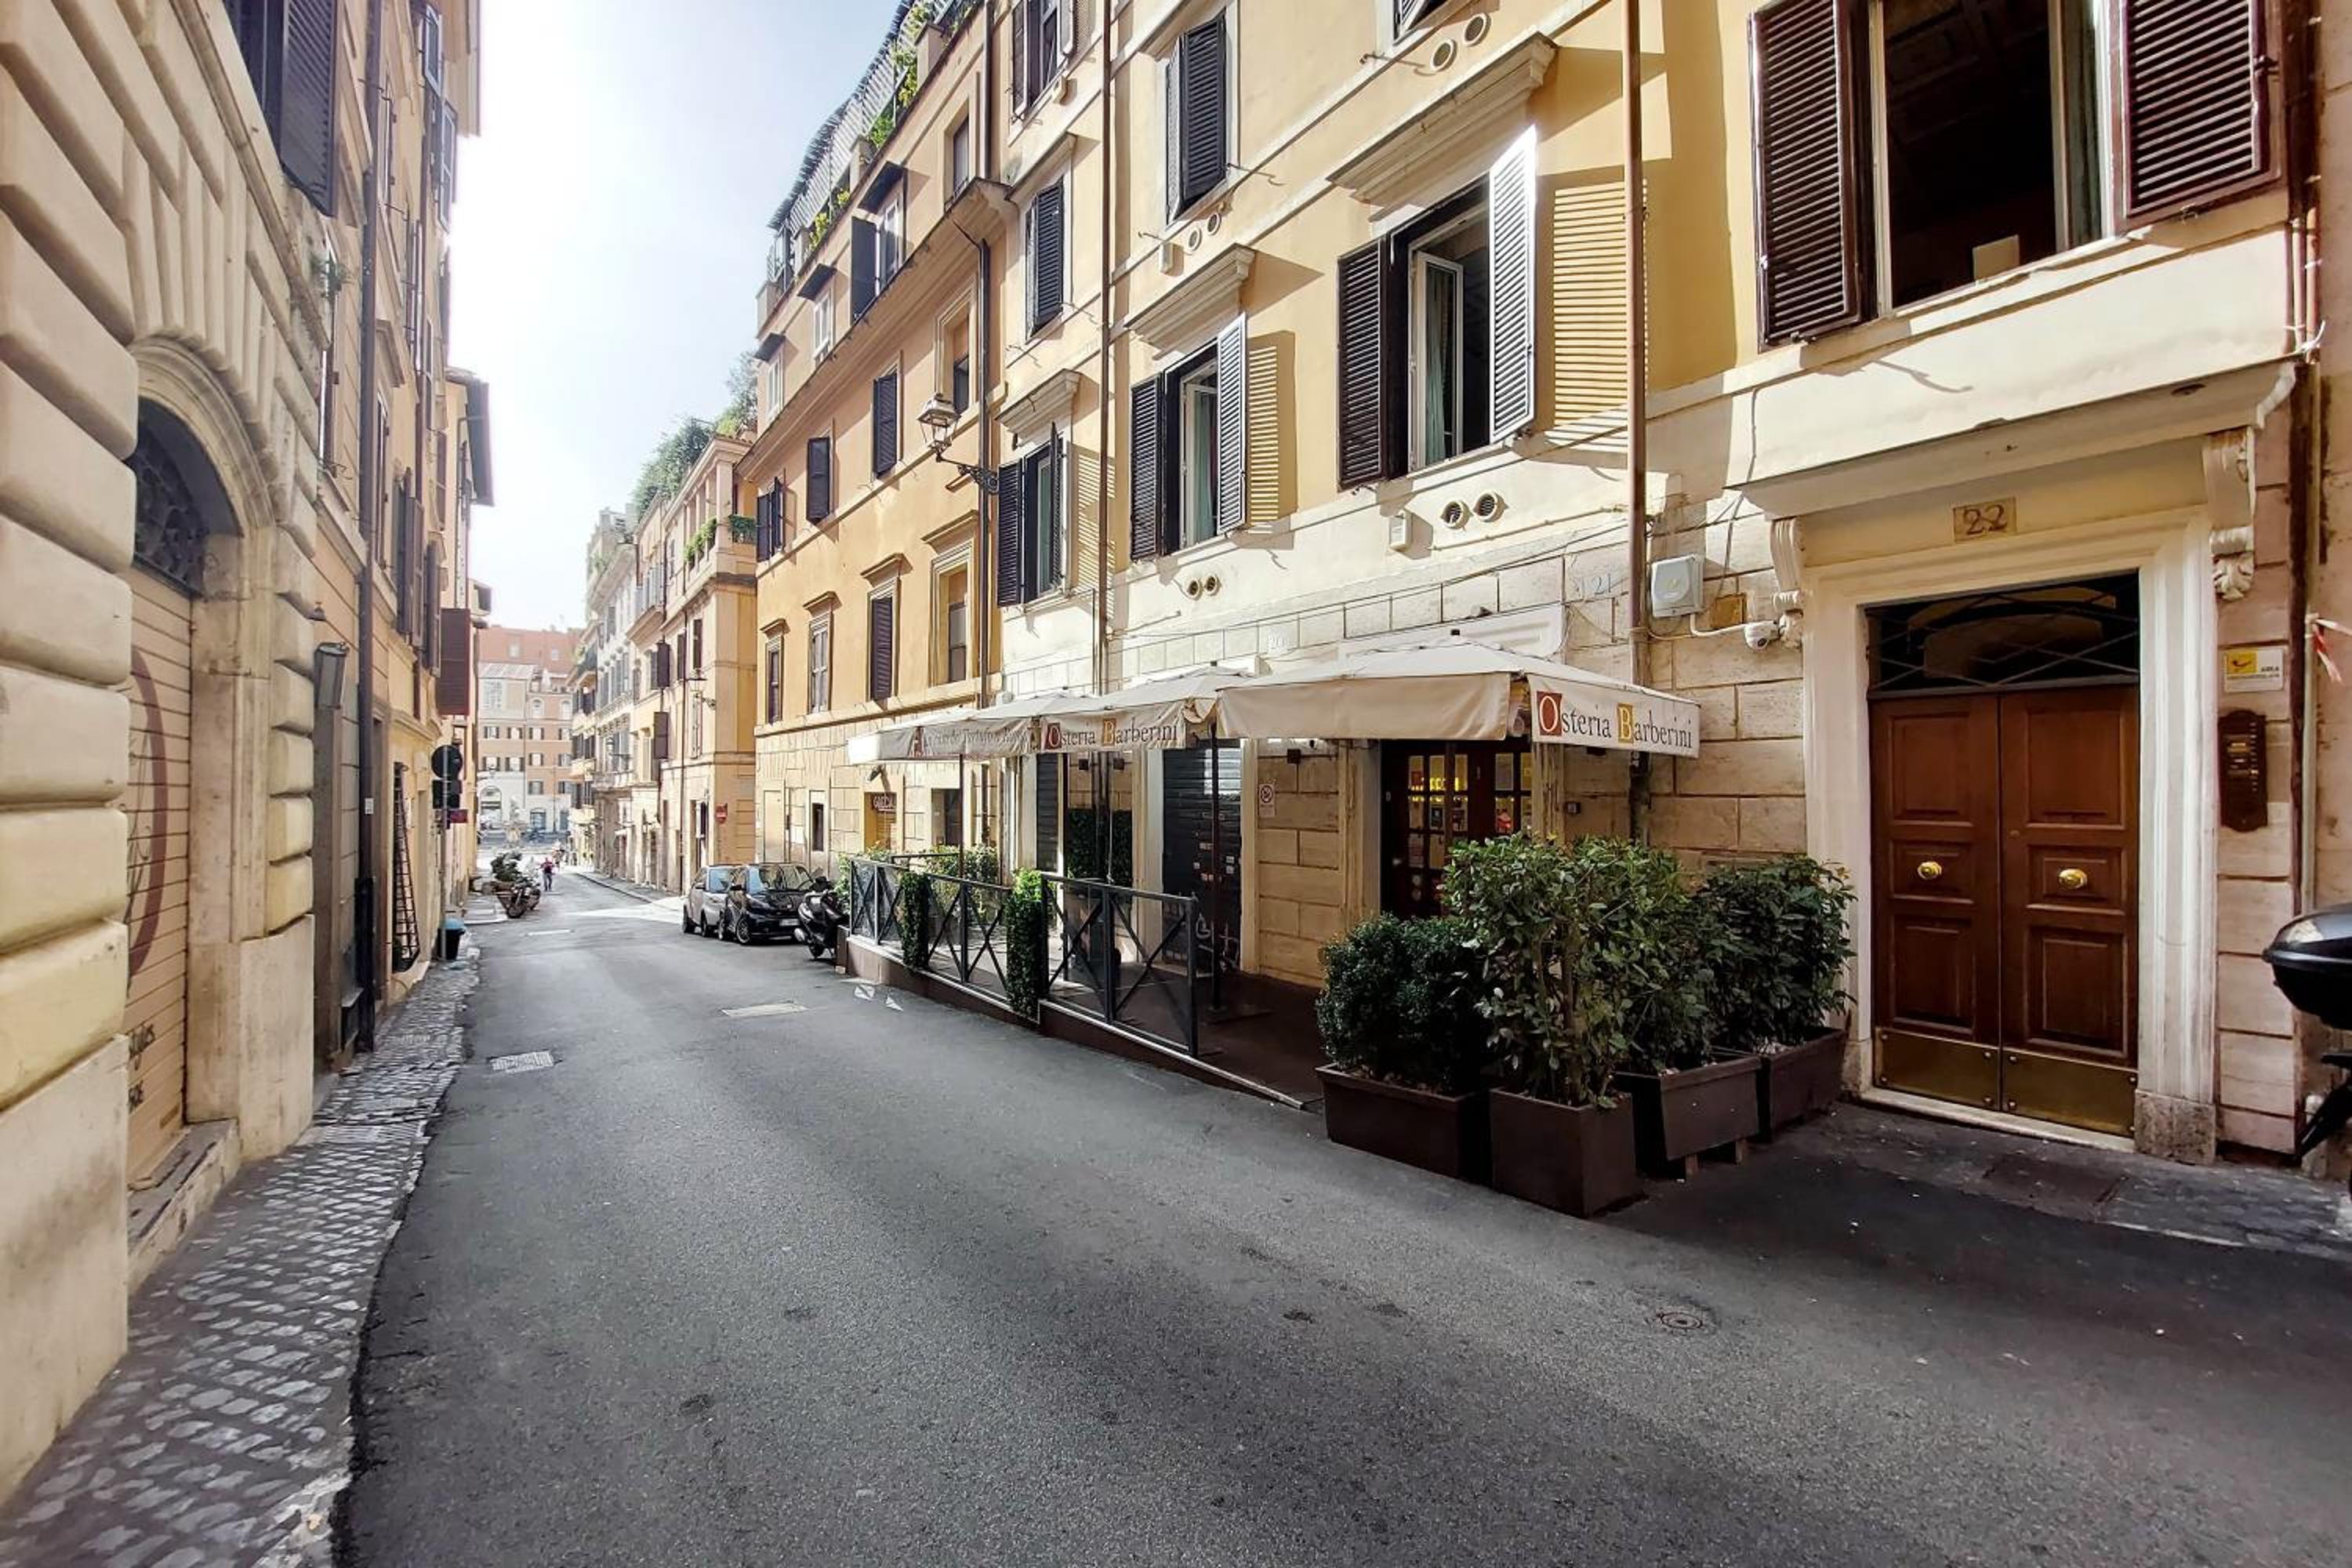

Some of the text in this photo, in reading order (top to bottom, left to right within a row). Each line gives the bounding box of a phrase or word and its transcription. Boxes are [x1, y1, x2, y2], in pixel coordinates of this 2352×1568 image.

[1964, 504, 2008, 535] 22
[1048, 716, 1177, 747] Osteria Barberini
[1539, 695, 1693, 748] Osteria Barberini
